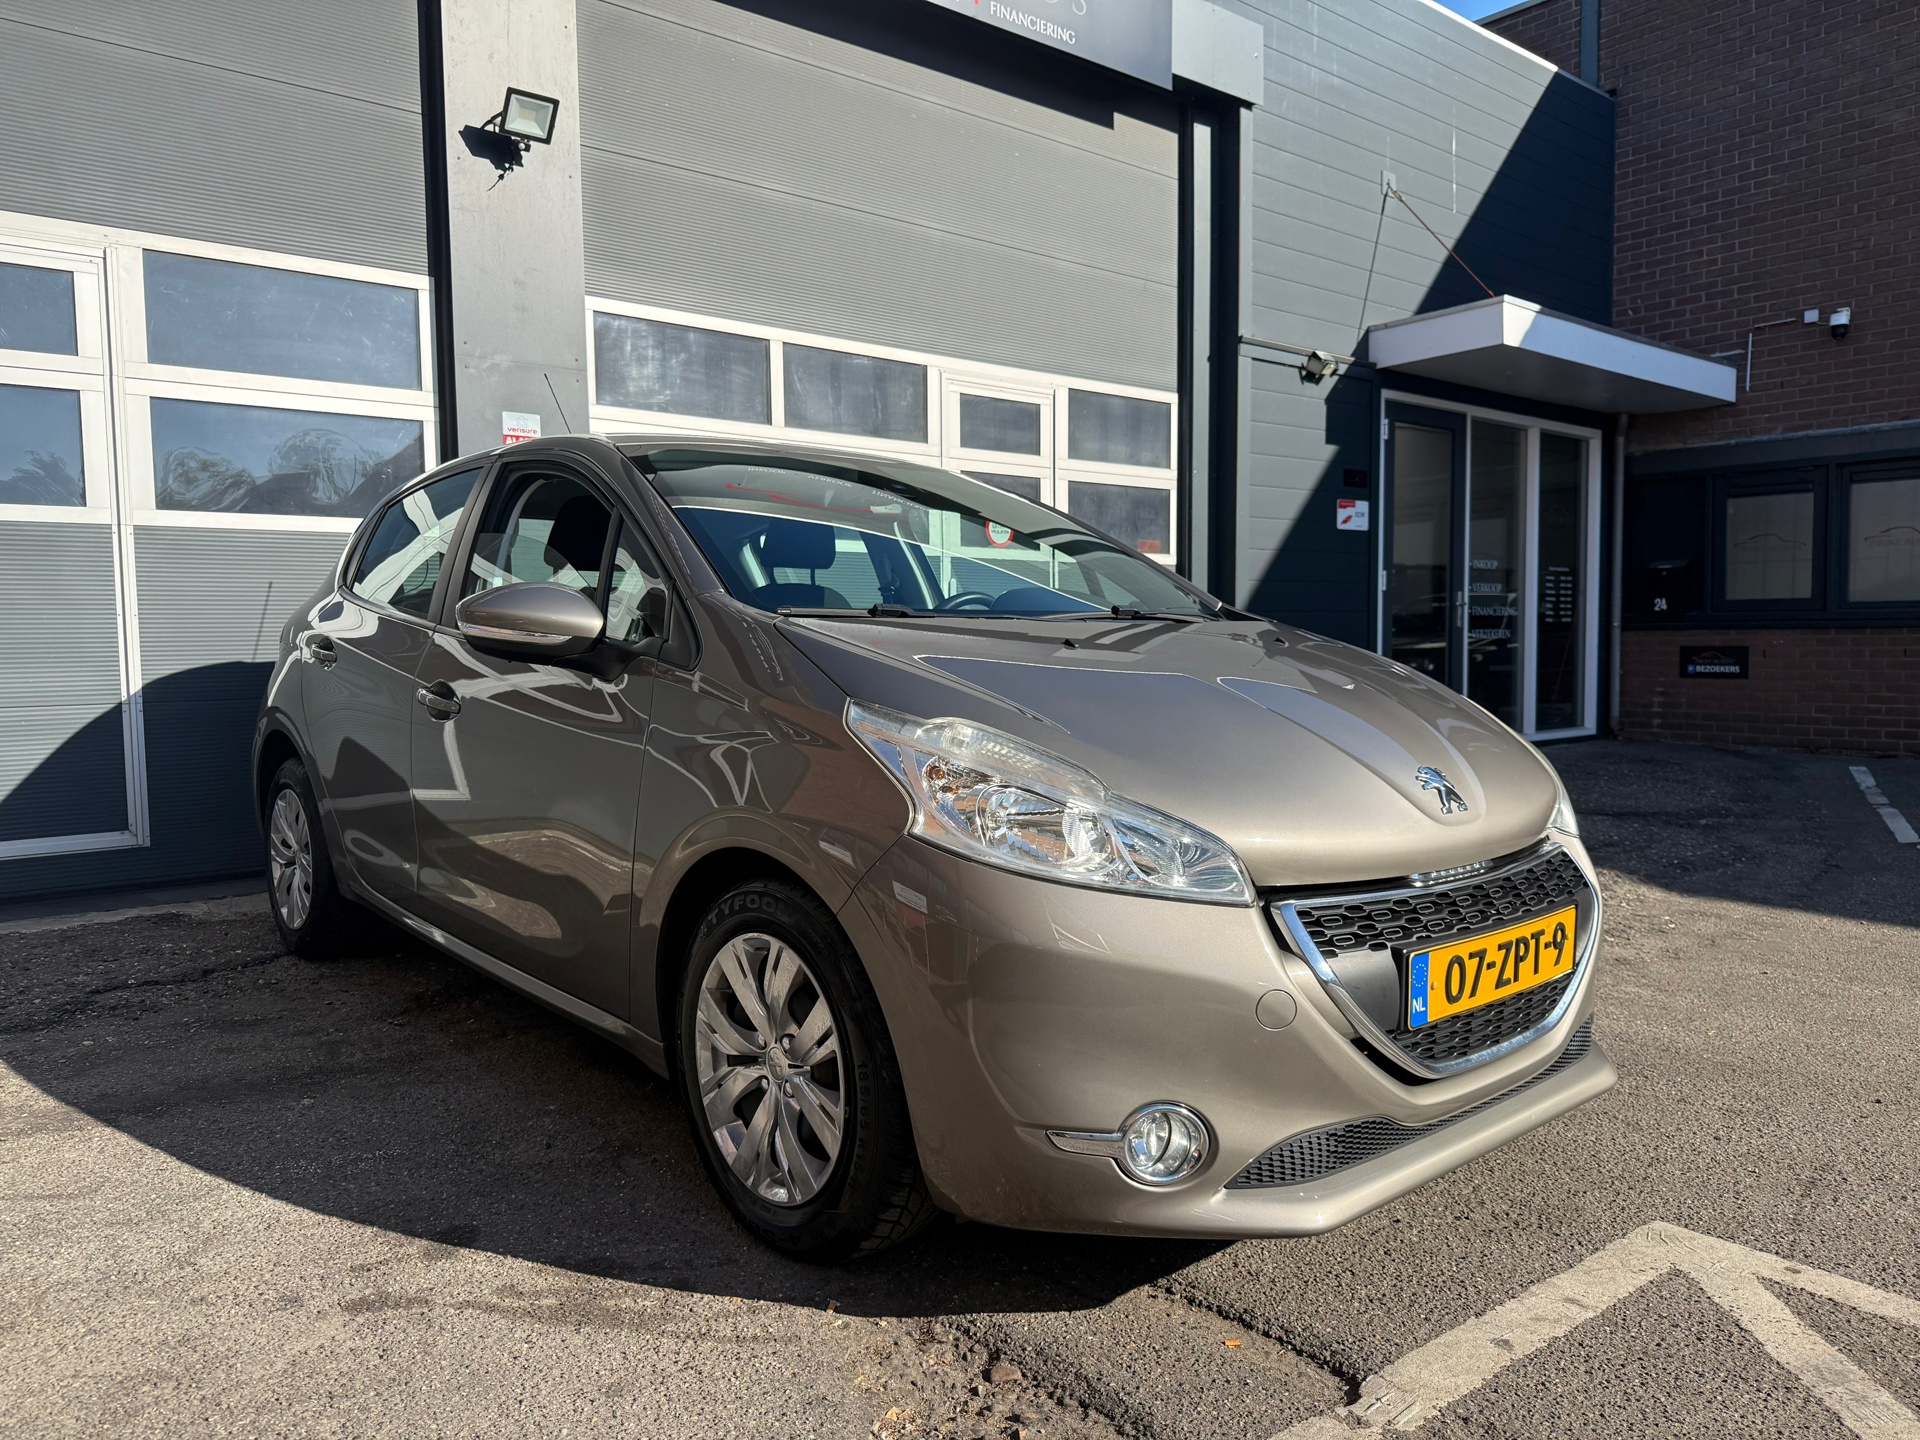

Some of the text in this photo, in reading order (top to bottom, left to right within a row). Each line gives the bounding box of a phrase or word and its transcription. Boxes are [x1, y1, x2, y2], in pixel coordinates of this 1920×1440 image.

[989, 1, 1076, 45] FINANCIERING
[1472, 559, 1499, 570] INKOOP
[1472, 582, 1503, 593] VERKOOP
[1654, 597, 1668, 611] 24
[1471, 605, 1519, 617] FINANCIERING
[1471, 628, 1511, 639] VERZEKEREN
[1695, 664, 1741, 674] BEZOEKERS
[1444, 920, 1568, 1006] 07-ZPT-9
[1412, 996, 1427, 1014] NL
